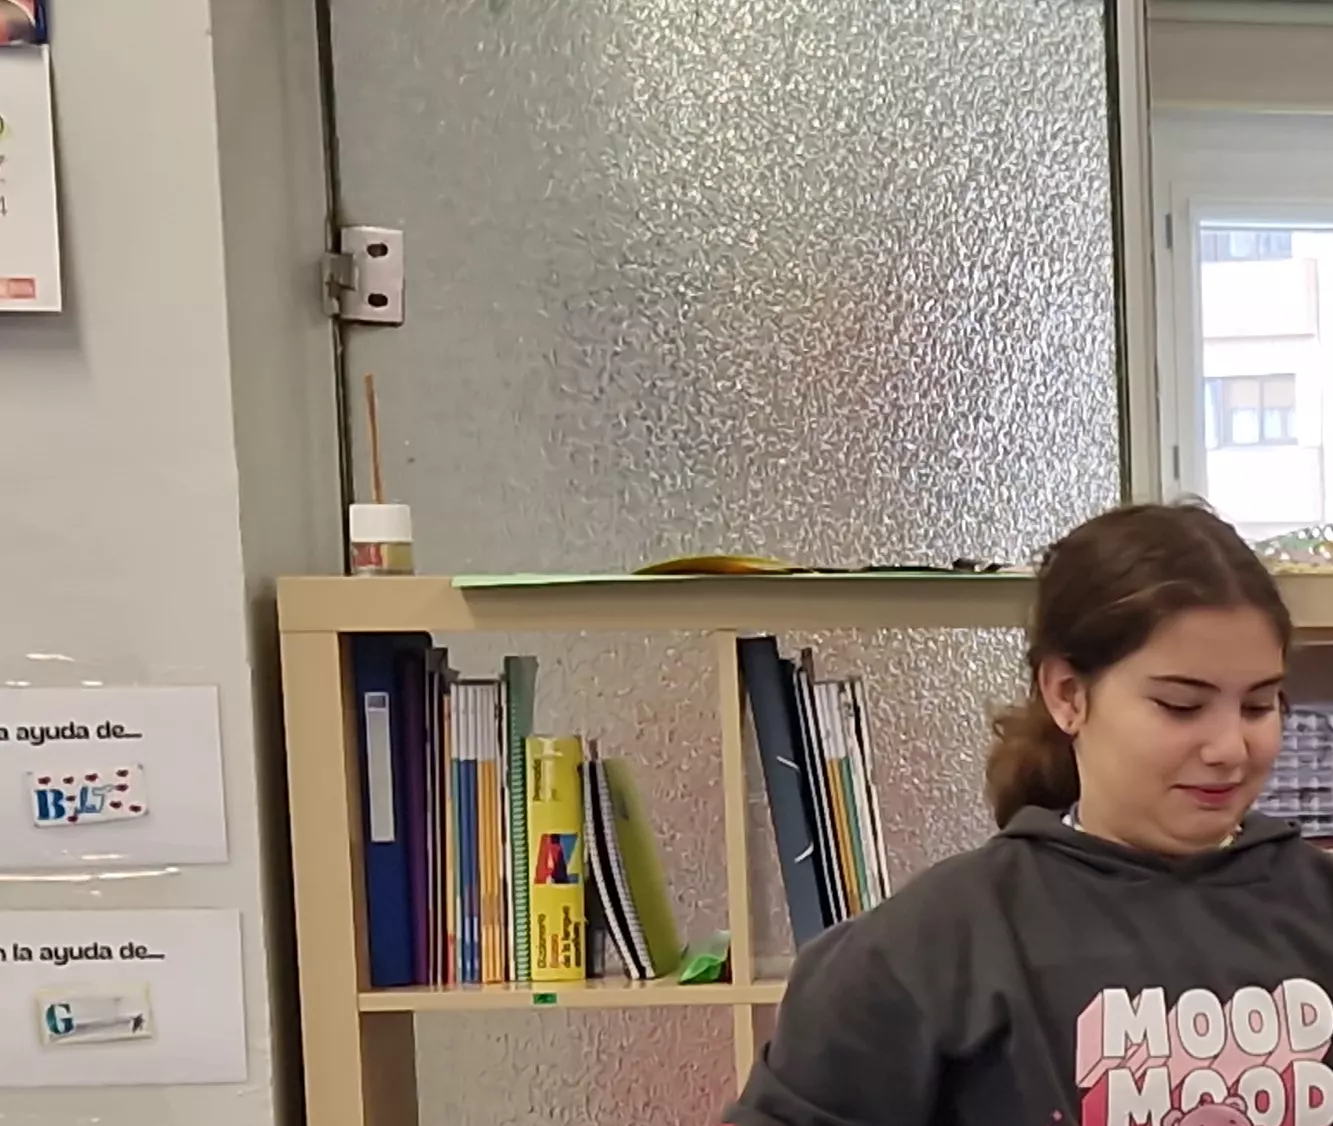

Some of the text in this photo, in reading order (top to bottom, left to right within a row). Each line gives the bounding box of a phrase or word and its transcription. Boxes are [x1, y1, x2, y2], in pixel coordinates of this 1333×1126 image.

[16, 721, 89, 746] ayuda
[13, 943, 33, 961] la
[40, 942, 113, 966] ayuda
